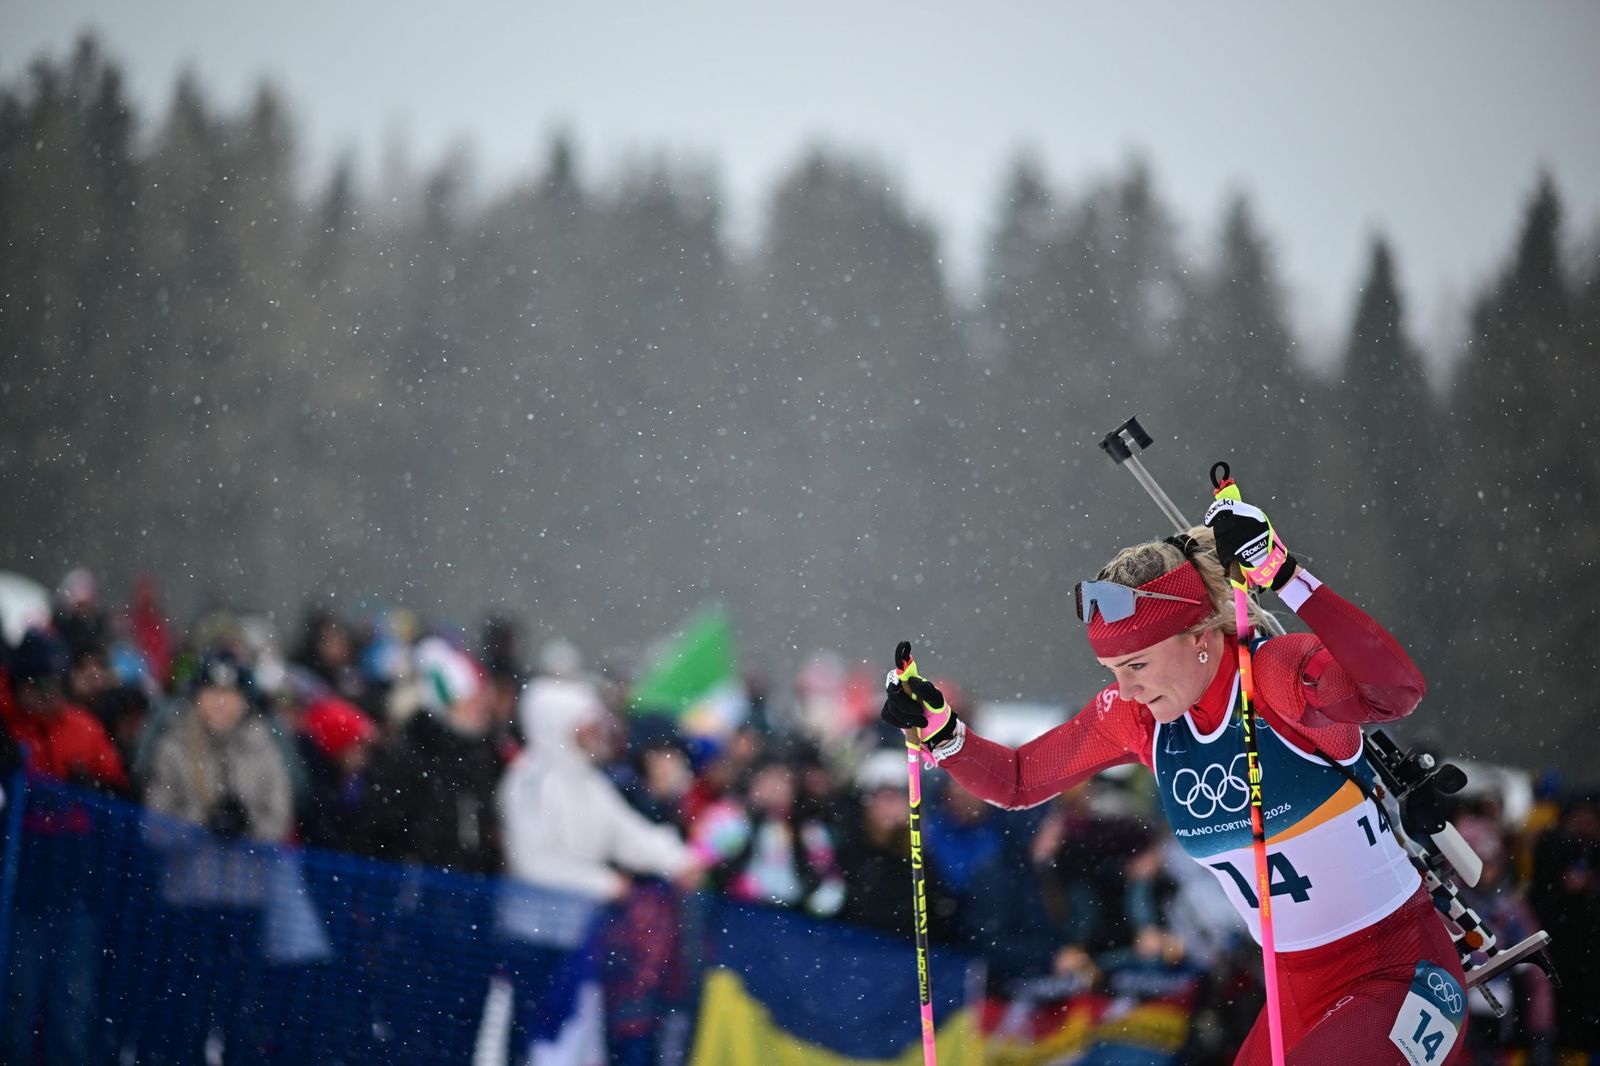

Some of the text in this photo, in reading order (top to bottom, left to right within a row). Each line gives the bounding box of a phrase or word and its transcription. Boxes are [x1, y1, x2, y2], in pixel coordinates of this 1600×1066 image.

[1251, 553, 1283, 583] LEKI
[1248, 752, 1262, 806] LEKI
[910, 813, 922, 869] LEKI
[1175, 802, 1292, 837] MILANO CORTIN 2026
[1357, 812, 1391, 847] 14
[1209, 852, 1313, 909] 14
[1412, 1009, 1445, 1063] 14
